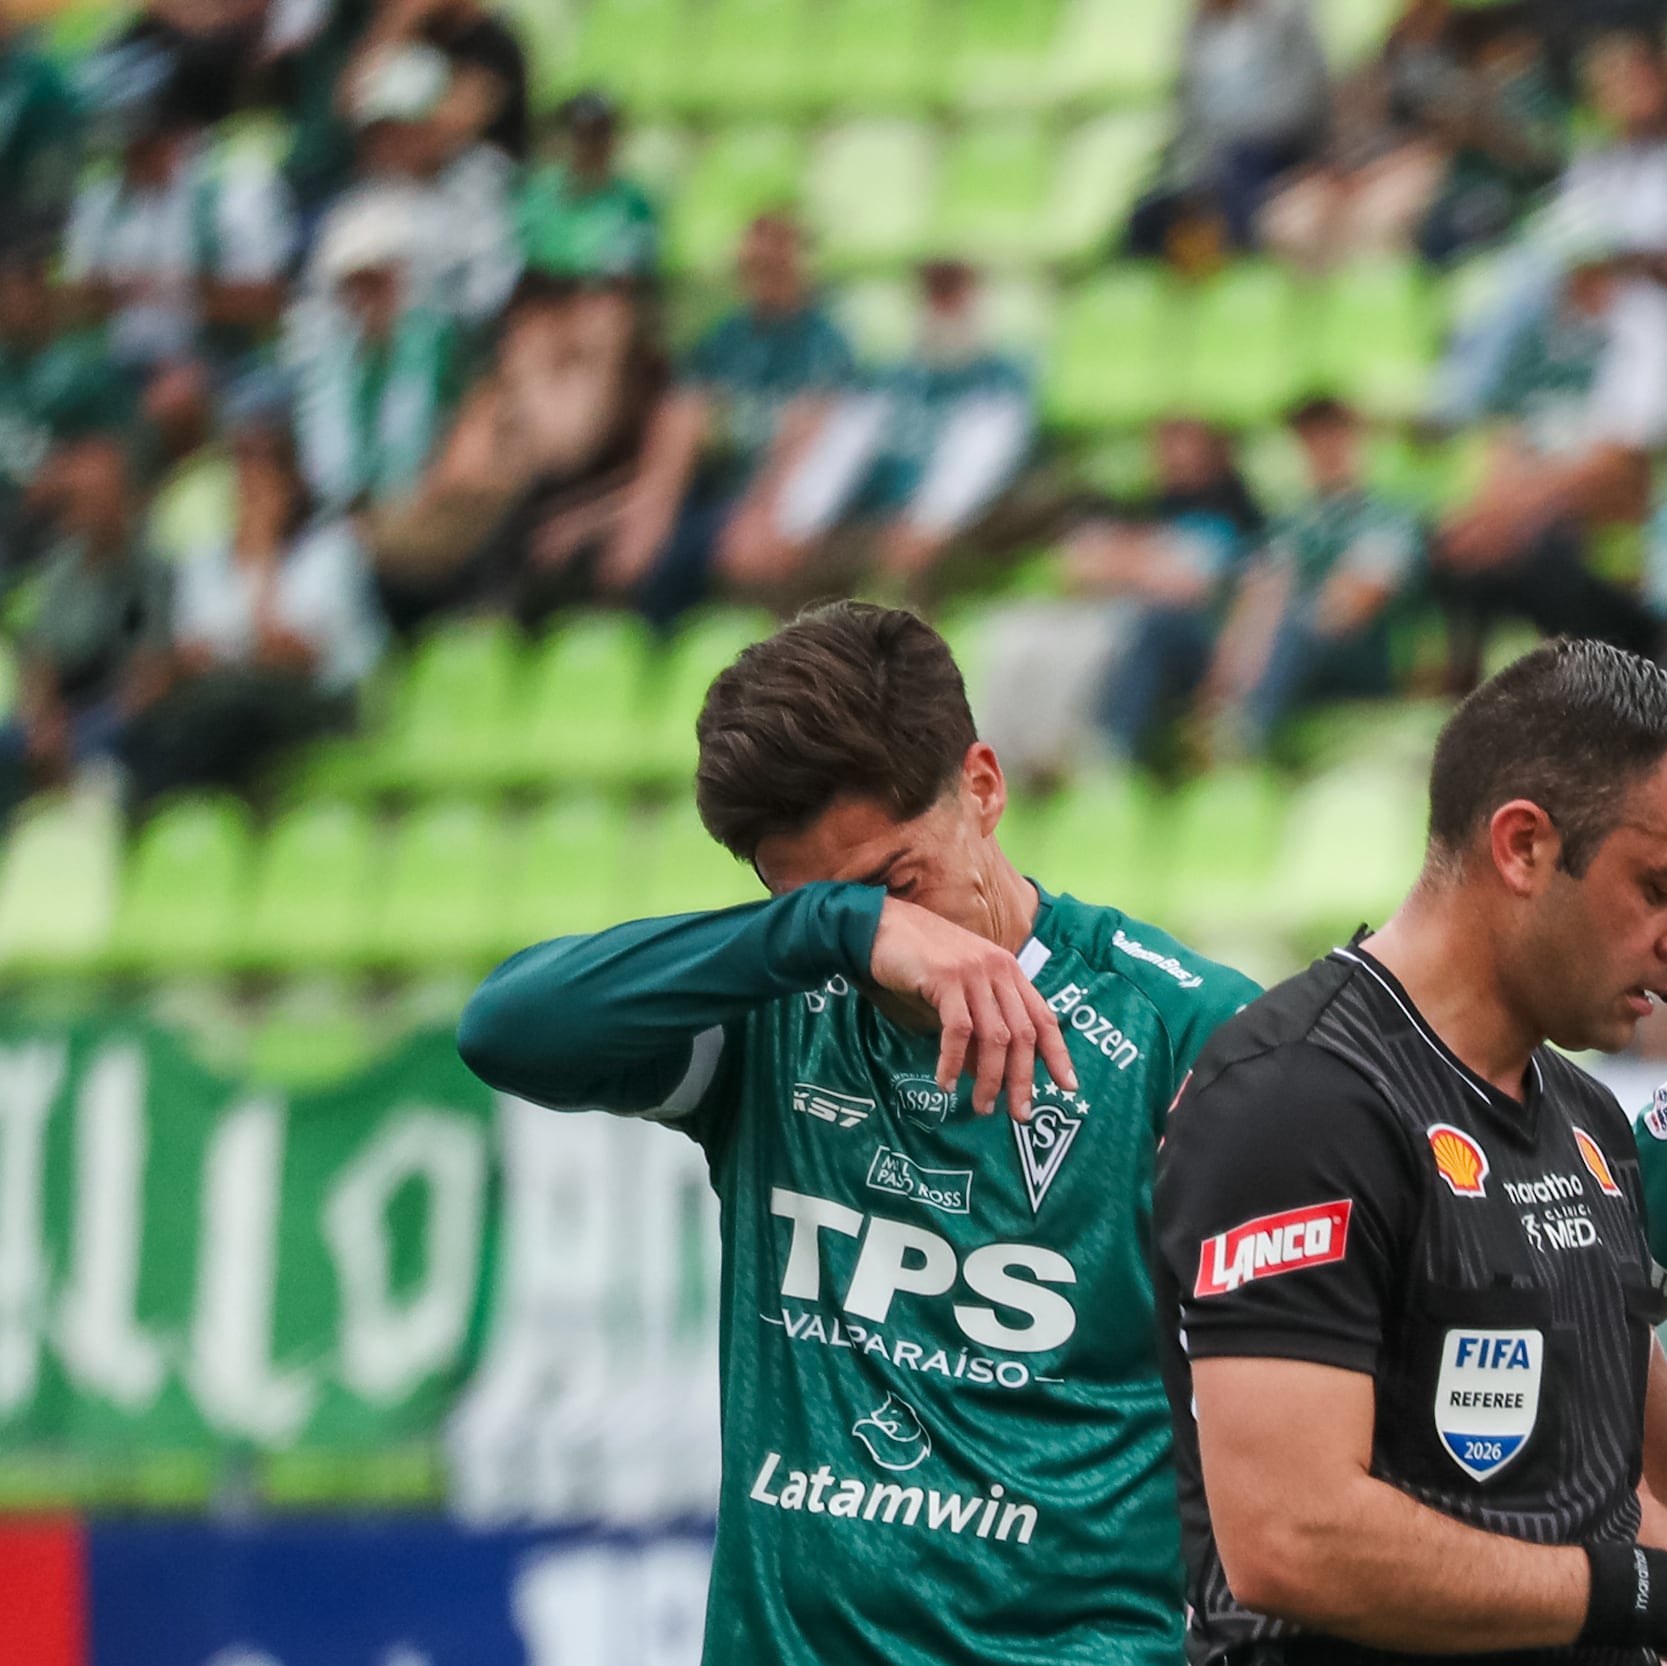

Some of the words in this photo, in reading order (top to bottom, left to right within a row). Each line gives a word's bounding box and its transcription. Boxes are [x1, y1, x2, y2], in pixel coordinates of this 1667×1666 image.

[898, 1088, 942, 1113] 1892
[918, 1182, 962, 1207] ROSS
[1503, 1173, 1584, 1205] maratho
[1545, 1205, 1592, 1222] CLINIC
[1541, 1218, 1603, 1251] MED
[1212, 1217, 1333, 1290] LANCO
[770, 1188, 1077, 1353] TPS
[782, 1308, 1030, 1390] VALPARAÍSO
[1455, 1337, 1530, 1370] FIFA
[1449, 1391, 1525, 1410] REFEREE
[1463, 1440, 1502, 1463] 2026
[748, 1452, 1040, 1545] Latamwin
